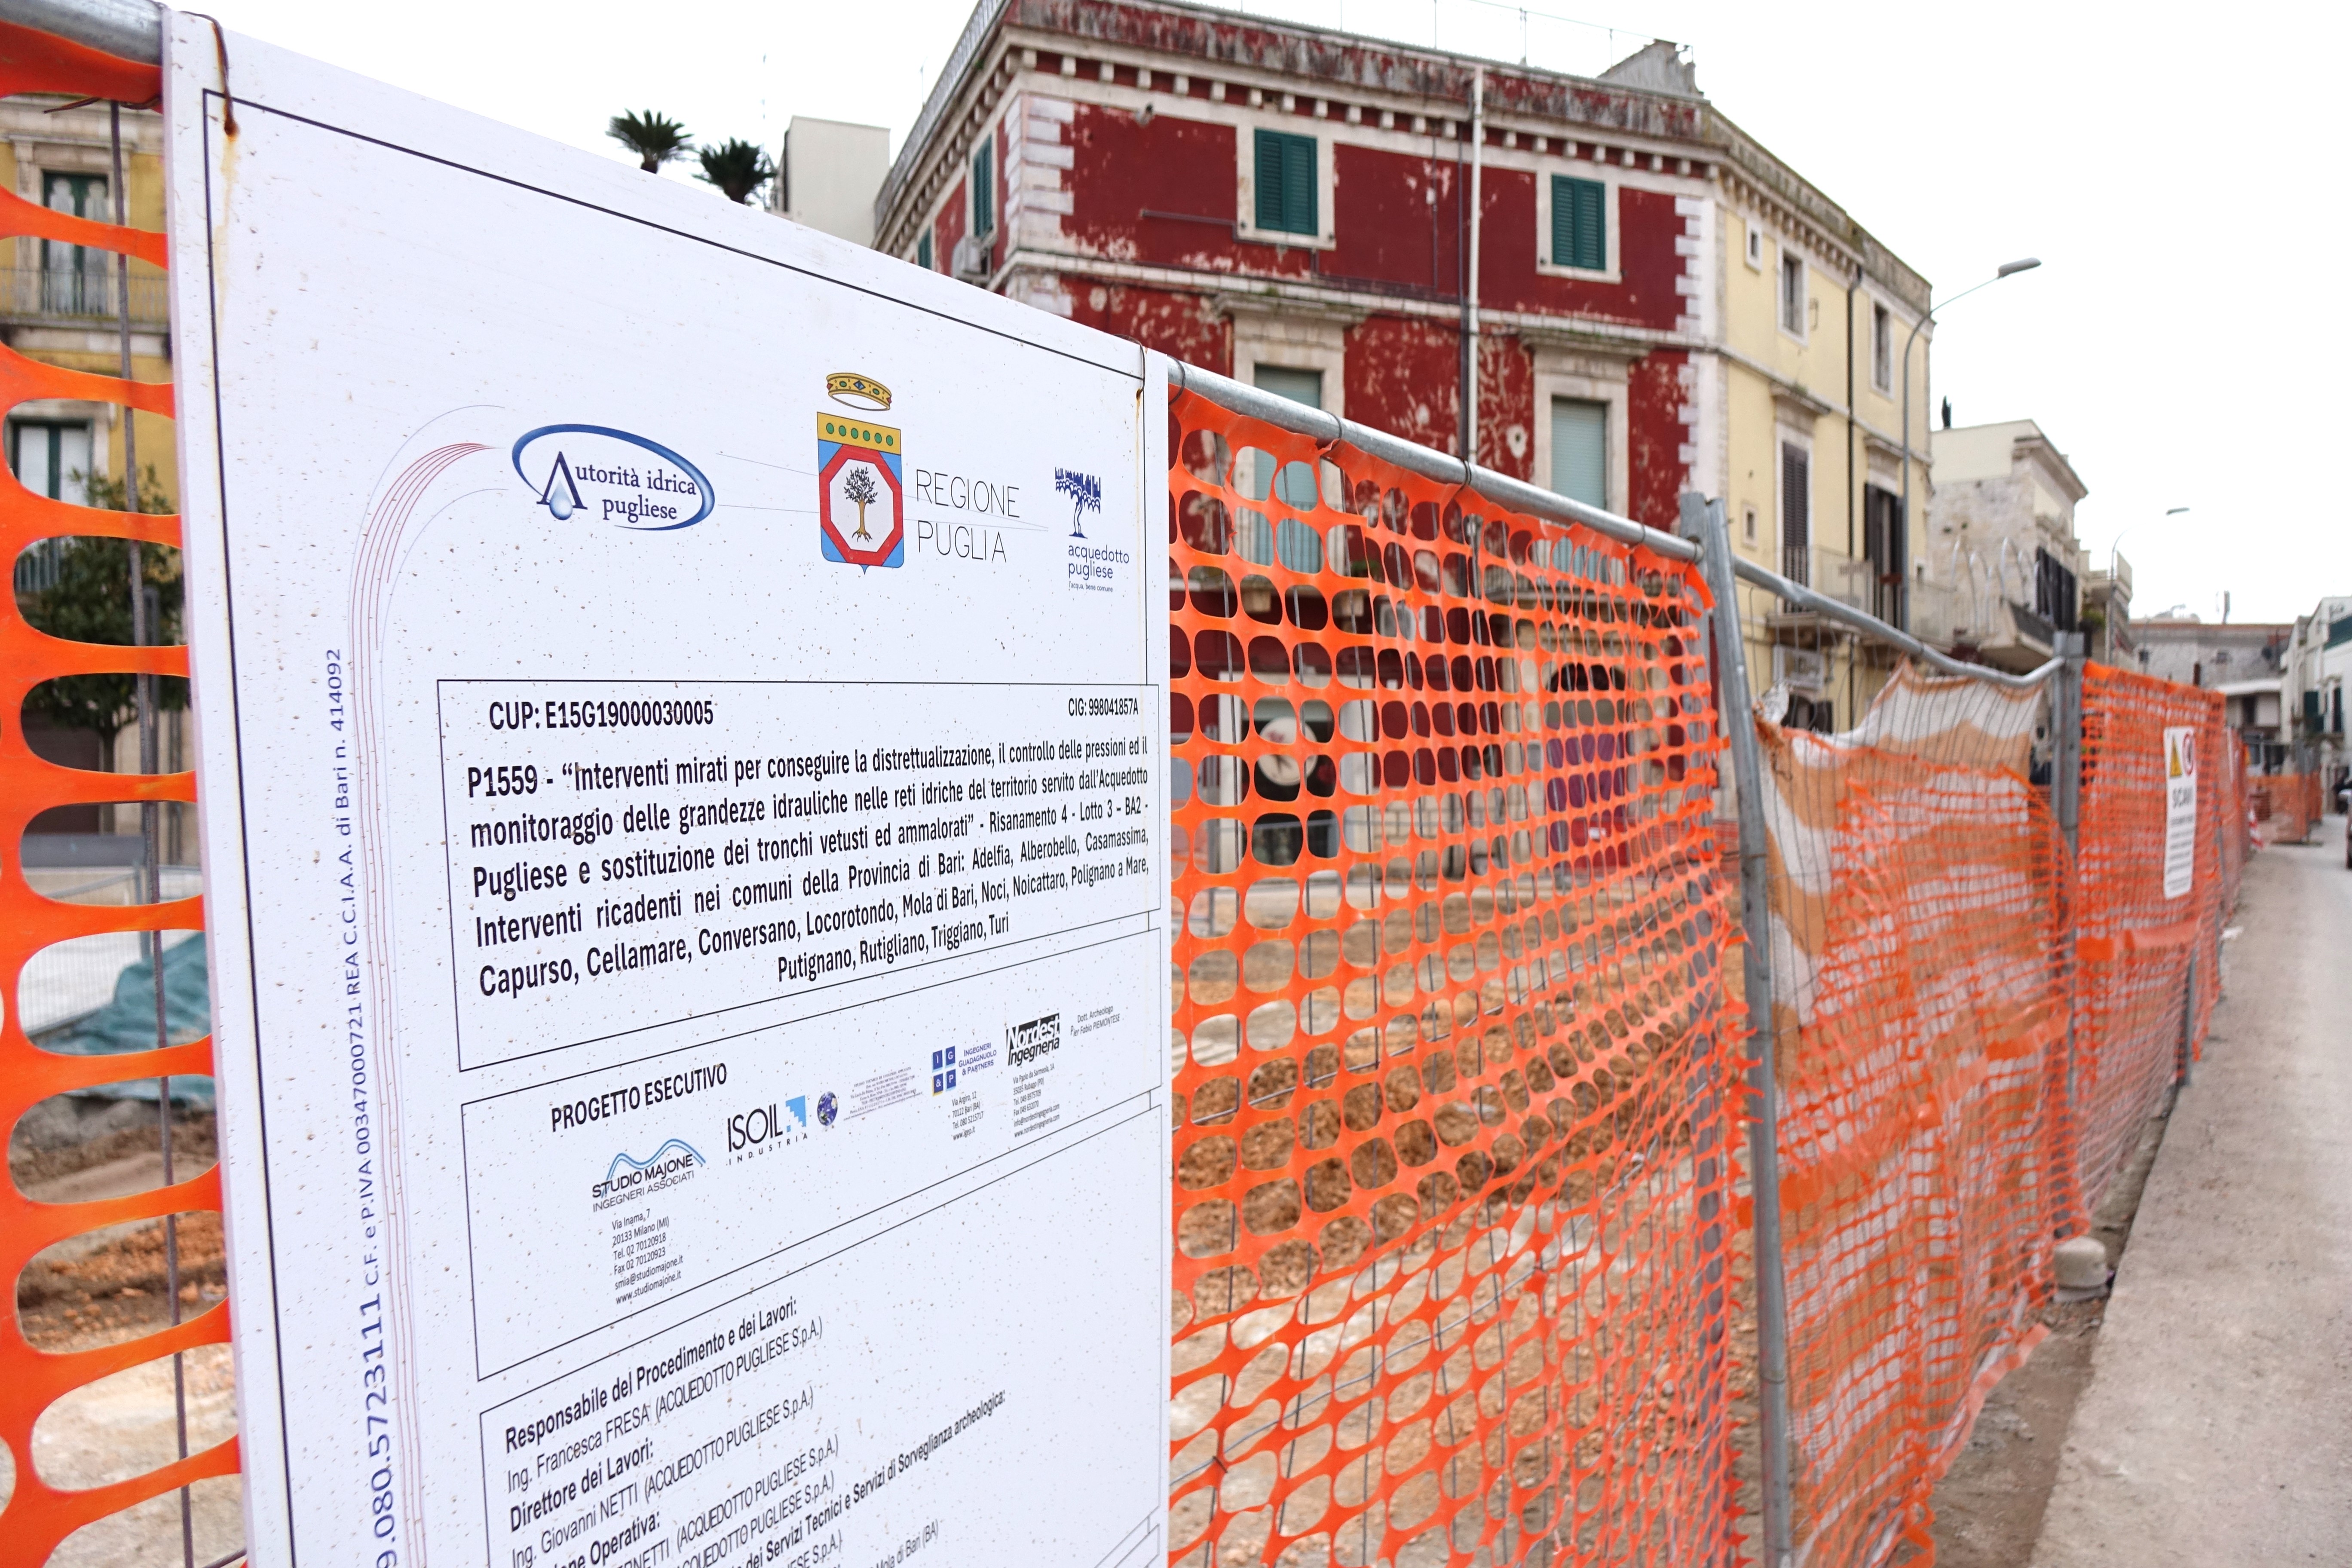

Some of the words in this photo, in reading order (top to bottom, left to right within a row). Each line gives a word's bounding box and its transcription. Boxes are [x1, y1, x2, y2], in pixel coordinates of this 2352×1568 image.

[536, 451, 640, 510] Autorità
[647, 469, 696, 495] idrica
[916, 469, 1020, 518] REGIONE
[602, 495, 677, 523] pugliese
[918, 520, 1007, 563] PUGLIA
[1068, 544, 1130, 564] acquedotto
[1068, 560, 1113, 581] pugliese
[1085, 582, 1096, 591] bene
[327, 649, 344, 732] 414092
[1068, 698, 1087, 717] CIG:
[1089, 697, 1139, 716] 998041857A
[489, 701, 540, 729] CUP:
[546, 701, 714, 728] E15G19000030005
[335, 739, 346, 758] n.
[468, 765, 538, 798] P1559
[676, 755, 728, 784] mirati
[735, 759, 761, 787] per
[768, 750, 850, 781] conseguire
[855, 749, 867, 772] la
[873, 744, 995, 772] distrettualizzazione,
[1009, 740, 1055, 763] controllo
[1059, 739, 1082, 760] delle
[1086, 737, 1126, 763] pressioni
[1129, 737, 1139, 755] ed
[333, 767, 349, 809] Bari
[336, 817, 351, 836] di
[471, 807, 613, 848] monitoraggio
[623, 803, 670, 833] delle
[680, 797, 765, 835] grandezze
[773, 789, 848, 819] idrauliche
[855, 786, 888, 812] nelle
[894, 783, 916, 808] reti
[922, 780, 963, 805] idriche
[968, 778, 986, 801] del
[991, 774, 1037, 799] territorio
[1042, 771, 1075, 793] servito
[473, 861, 567, 901] Pugliese
[601, 845, 715, 881] sostituzione
[724, 838, 749, 866] dei
[757, 830, 813, 862] tronchi
[820, 825, 868, 854] vetusti
[875, 822, 891, 847] ed
[989, 807, 1057, 833] Risanamento
[1080, 801, 1103, 821] Lotto
[1125, 796, 1141, 815] BA2
[339, 844, 358, 945] C.C.I.A.A.
[476, 903, 582, 947] Interventi
[597, 889, 681, 929] ricadenti
[694, 884, 720, 913] nei
[732, 873, 792, 907] comuni
[802, 868, 839, 896] della
[848, 858, 910, 889] Provincia
[919, 854, 930, 878] di
[938, 850, 965, 876] Bari:
[972, 845, 1014, 870] Adelfia,
[1020, 836, 1080, 863] Alberobello,
[1085, 826, 1149, 852] Casamassima,
[480, 958, 579, 999] Capurso,
[587, 937, 692, 977] Cellamare,
[699, 919, 801, 956] Conversano,
[806, 898, 898, 936] Locorotondo,
[903, 892, 932, 918] Mola
[937, 888, 947, 911] di
[952, 883, 977, 909] Bari,
[982, 878, 1009, 903] Noci,
[1013, 871, 1068, 897] Noicattaro,
[1071, 861, 1115, 888] Polignano
[1126, 856, 1149, 875] Mare,
[778, 948, 856, 982] Putignano,
[860, 932, 929, 965] Rutigliano,
[931, 920, 987, 951] Triggiano,
[989, 911, 1009, 935] Turi
[345, 951, 361, 995] REA
[1006, 1014, 1060, 1051] Nordest
[1070, 1025, 1079, 1037] Pier
[1080, 1025, 1092, 1035] Fabio
[1093, 1014, 1121, 1029] PIEMONTESE
[1077, 1014, 1089, 1023] Dott.
[1090, 1005, 1114, 1019] Archeologo
[959, 1050, 997, 1068] GUADAGNUOLO
[964, 1042, 992, 1057] INGEGNERI
[967, 1060, 994, 1075] PARTNERS
[1008, 1037, 1060, 1067] Ingegneria
[347, 1002, 371, 1155] 00347000721
[551, 1086, 640, 1133] PROGETTO
[645, 1063, 728, 1106] ESECUTIVO
[727, 1103, 783, 1152] ISOIL
[729, 1133, 808, 1165] INDUSTRIA
[358, 1159, 375, 1219] P.IVA
[592, 1171, 642, 1198] STUDIO
[645, 1154, 694, 1181] MAJONE
[593, 1188, 645, 1213] INGEGNERI
[646, 1170, 694, 1194] ASSOCIATI
[612, 1220, 622, 1231] Via
[612, 1230, 632, 1246] 20133
[634, 1223, 655, 1238] Milano
[657, 1216, 669, 1231] (MI)
[613, 1248, 625, 1260] Tel.
[626, 1245, 634, 1255] 02
[636, 1232, 667, 1252] 70120918
[364, 1245, 380, 1286] C.F.
[614, 1263, 625, 1275] Fax
[626, 1259, 635, 1271] 02
[636, 1246, 666, 1267] 70120923
[615, 1255, 683, 1290] smia@studiomajone.it
[616, 1270, 682, 1305] www.studiomajone.it
[505, 1387, 607, 1453] Responsabile
[612, 1369, 632, 1403] del
[637, 1331, 725, 1392] Procedimento
[739, 1313, 755, 1341] dei
[759, 1295, 796, 1331] Lavori:
[507, 1467, 533, 1493] Ing.
[536, 1430, 602, 1477] Francesca
[606, 1403, 649, 1442] FRESA
[655, 1360, 734, 1423] (ACQUEDOTTO
[736, 1332, 790, 1376] PUGLIESE
[792, 1316, 822, 1348] S.p.A.)
[510, 1485, 576, 1532] Direttore
[581, 1461, 603, 1494] dei
[607, 1437, 654, 1481] Lavori:
[541, 1505, 597, 1553] Giovanni
[600, 1481, 638, 1522] NETTI
[645, 1436, 724, 1504] (ACQUEDOTTO
[726, 1404, 780, 1452] PUGLIESE
[783, 1385, 814, 1420] S.p.A.)
[766, 1520, 802, 1562] Servizi
[805, 1494, 842, 1535] Tecnici
[853, 1466, 885, 1503] Servizi
[888, 1458, 896, 1481] di
[898, 1425, 953, 1473] Sorveglianza
[954, 1390, 1006, 1435] archeologica:
[589, 1510, 661, 1567] Operativa:
